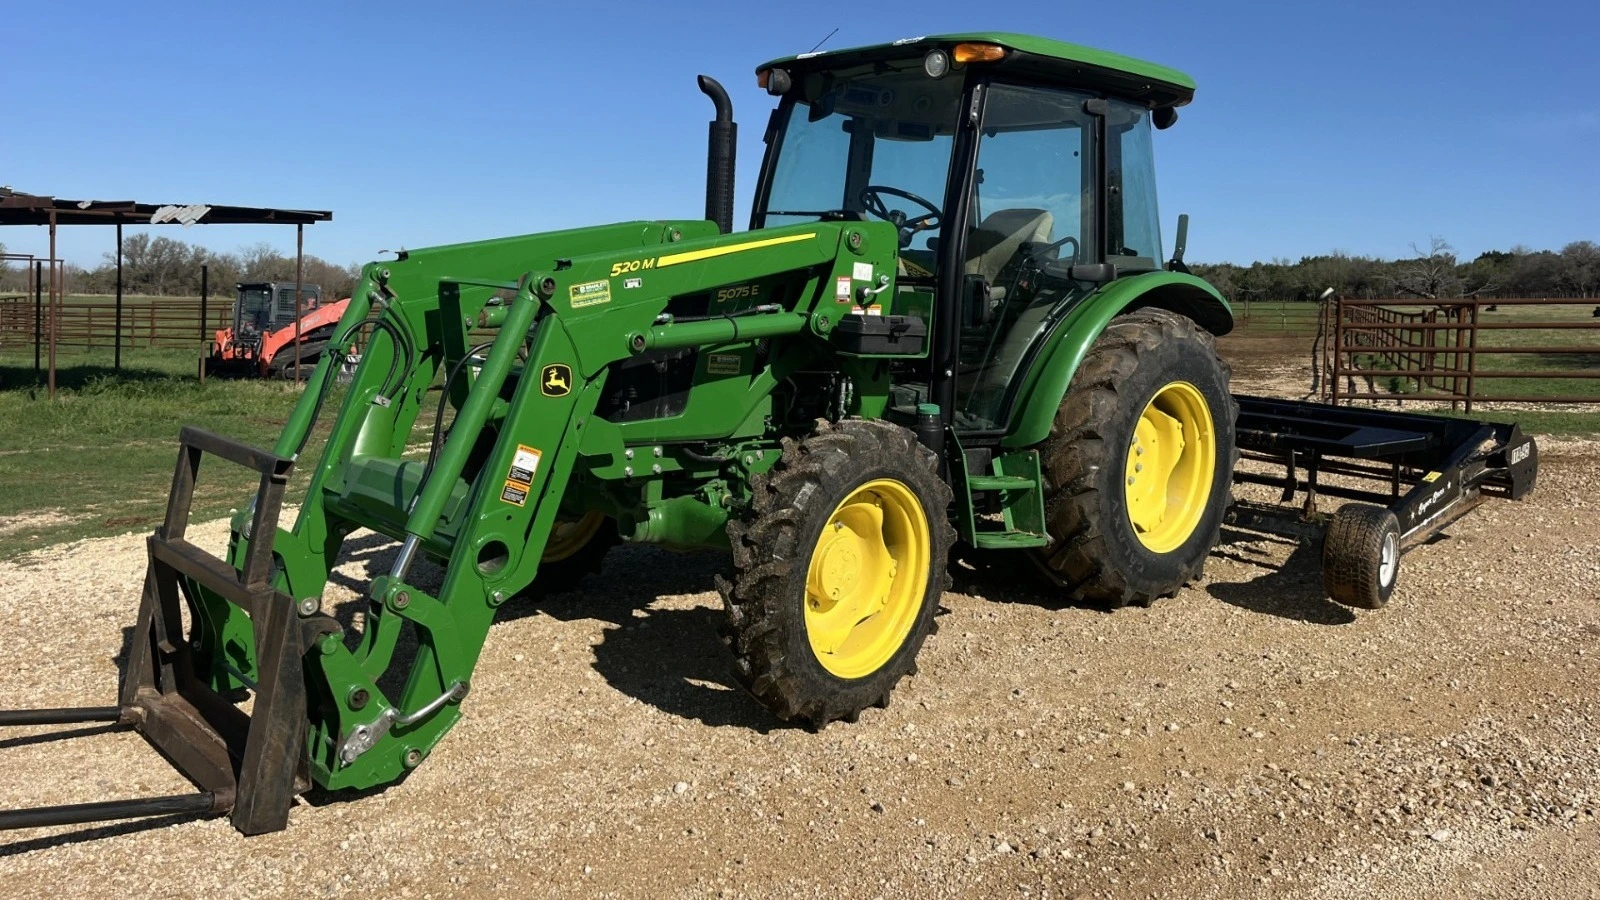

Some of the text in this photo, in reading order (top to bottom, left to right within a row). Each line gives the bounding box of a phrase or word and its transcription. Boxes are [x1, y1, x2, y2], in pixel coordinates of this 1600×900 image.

[610, 258, 655, 277] 520 M
[717, 285, 759, 303] 5075 E
